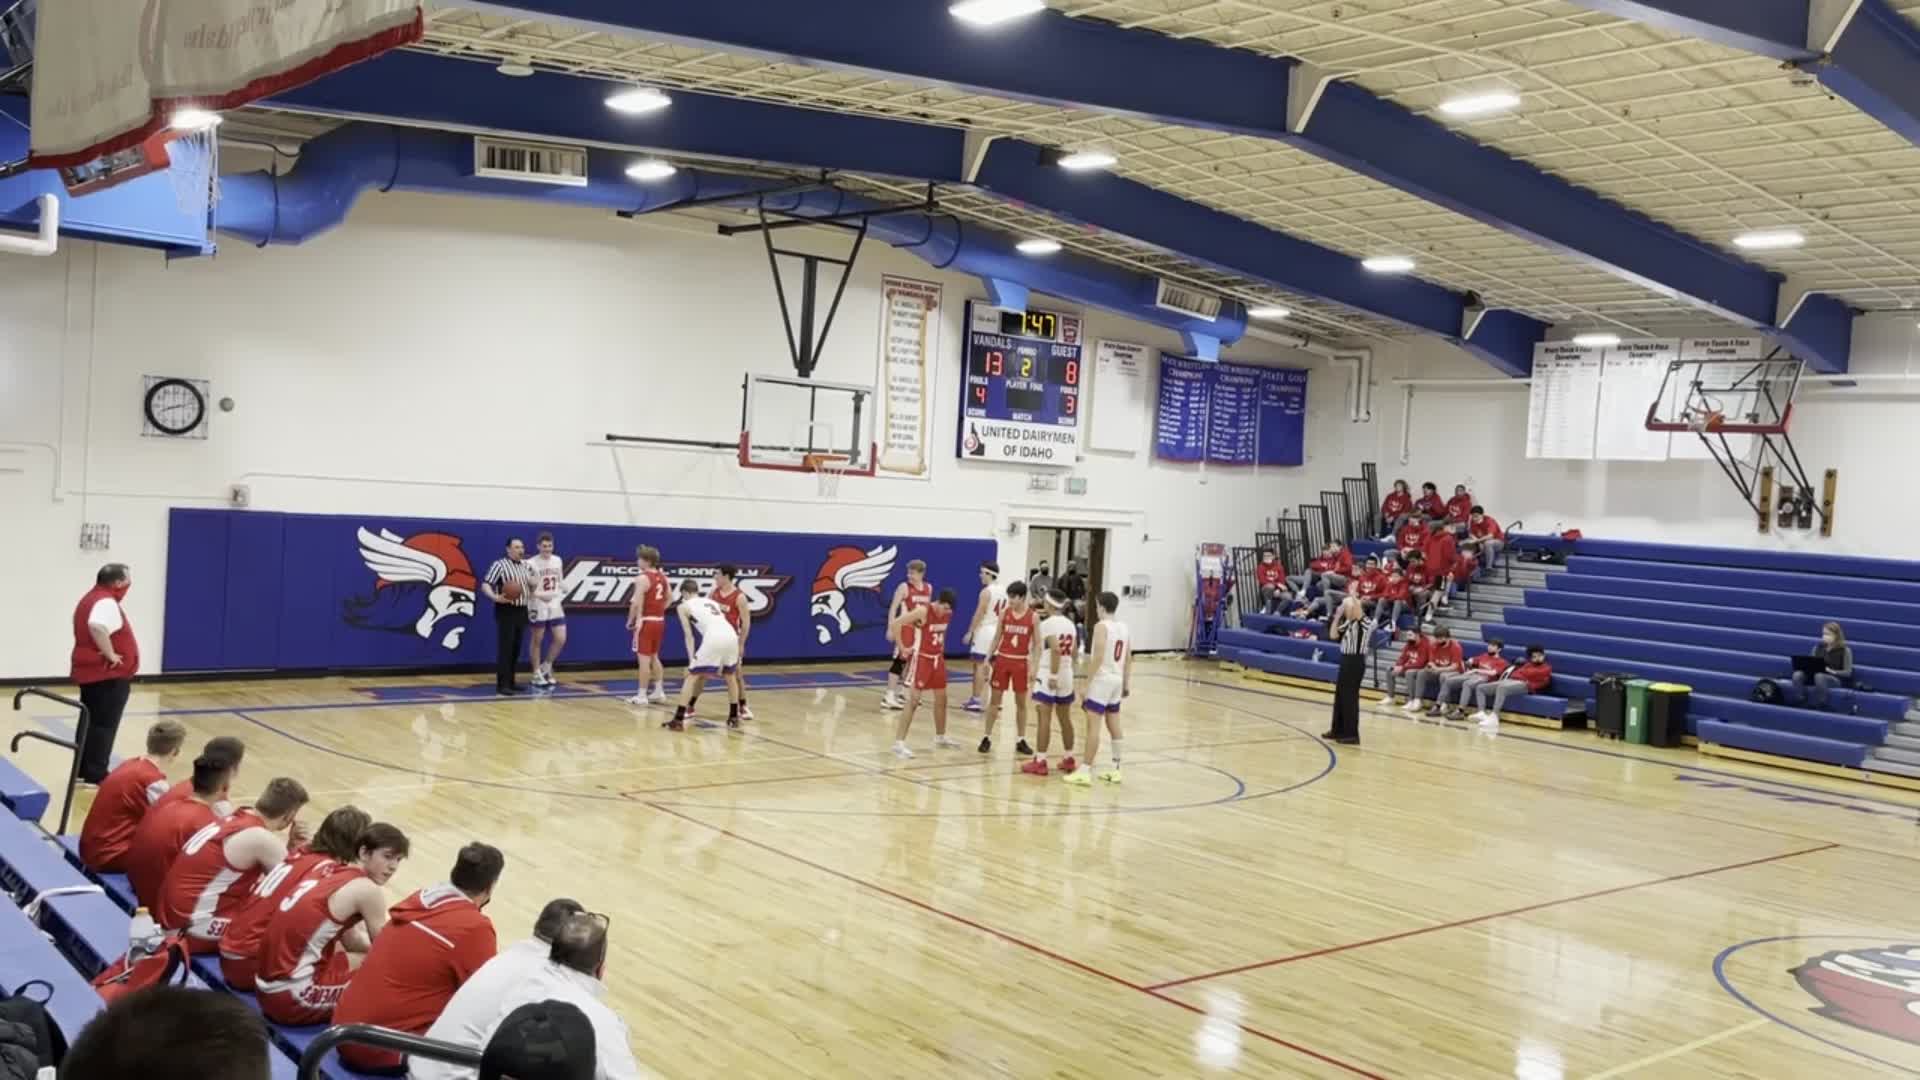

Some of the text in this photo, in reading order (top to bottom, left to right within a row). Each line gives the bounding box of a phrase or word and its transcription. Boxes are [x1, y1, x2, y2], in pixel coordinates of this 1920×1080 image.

[1021, 312, 1054, 337] 7:47
[973, 333, 1012, 349] VANDALS
[1051, 344, 1077, 357] GUEST
[985, 351, 1003, 376] 13
[1021, 358, 1032, 377] 2
[1066, 361, 1077, 385] 8
[1005, 379, 1028, 390] PLAYER
[976, 387, 986, 404] 4
[1066, 396, 1075, 415] 3
[982, 425, 1076, 445] UNITED DAIRYMEN
[1003, 444, 1054, 460] OF IDAHO
[655, 584, 664, 601] 2
[1010, 635, 1019, 648] 4
[1114, 640, 1124, 662] 0
[279, 879, 319, 912] 3
